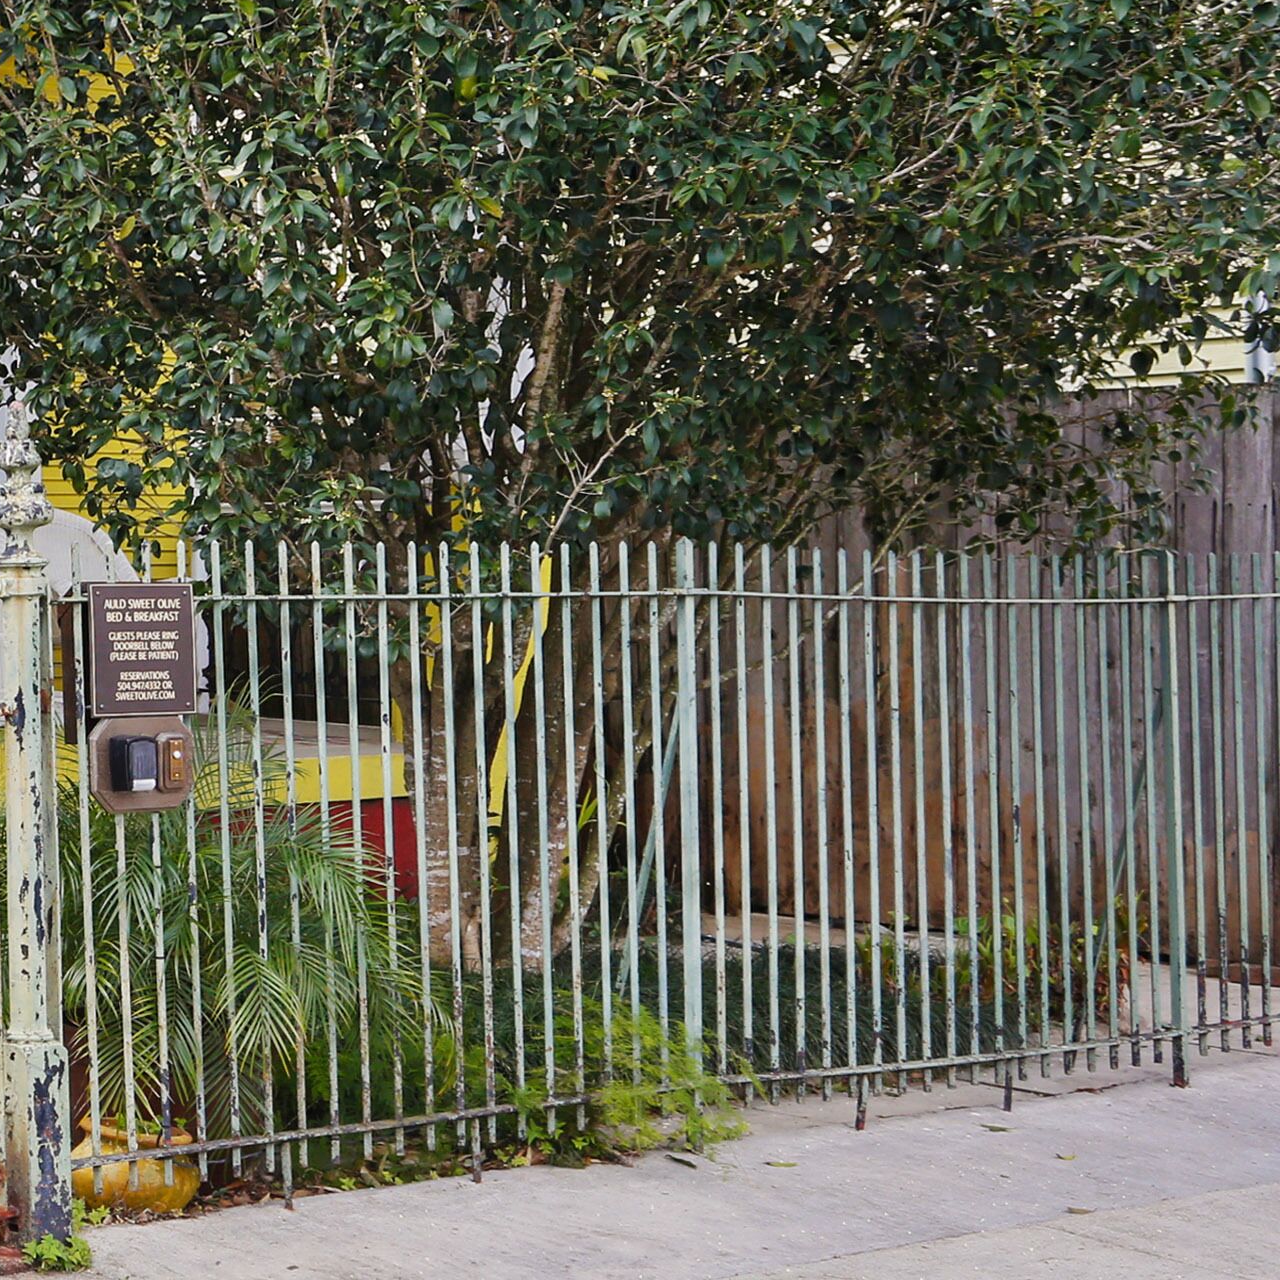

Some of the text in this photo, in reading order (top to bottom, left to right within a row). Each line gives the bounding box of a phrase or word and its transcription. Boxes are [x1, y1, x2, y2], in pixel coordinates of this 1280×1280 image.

[104, 598, 181, 609] AULD SWEET OLIVE
[106, 611, 179, 622] BED & BREAKFAST
[108, 631, 179, 641] GUESTS PLEASE RING
[113, 641, 175, 650] DOORBELL BELOW
[110, 650, 179, 662] (PLEASE BE PATIENT)
[120, 671, 170, 680] RESERVATIONS
[162, 681, 173, 689] OR
[115, 691, 175, 701] SWEETOLIVE.COM
